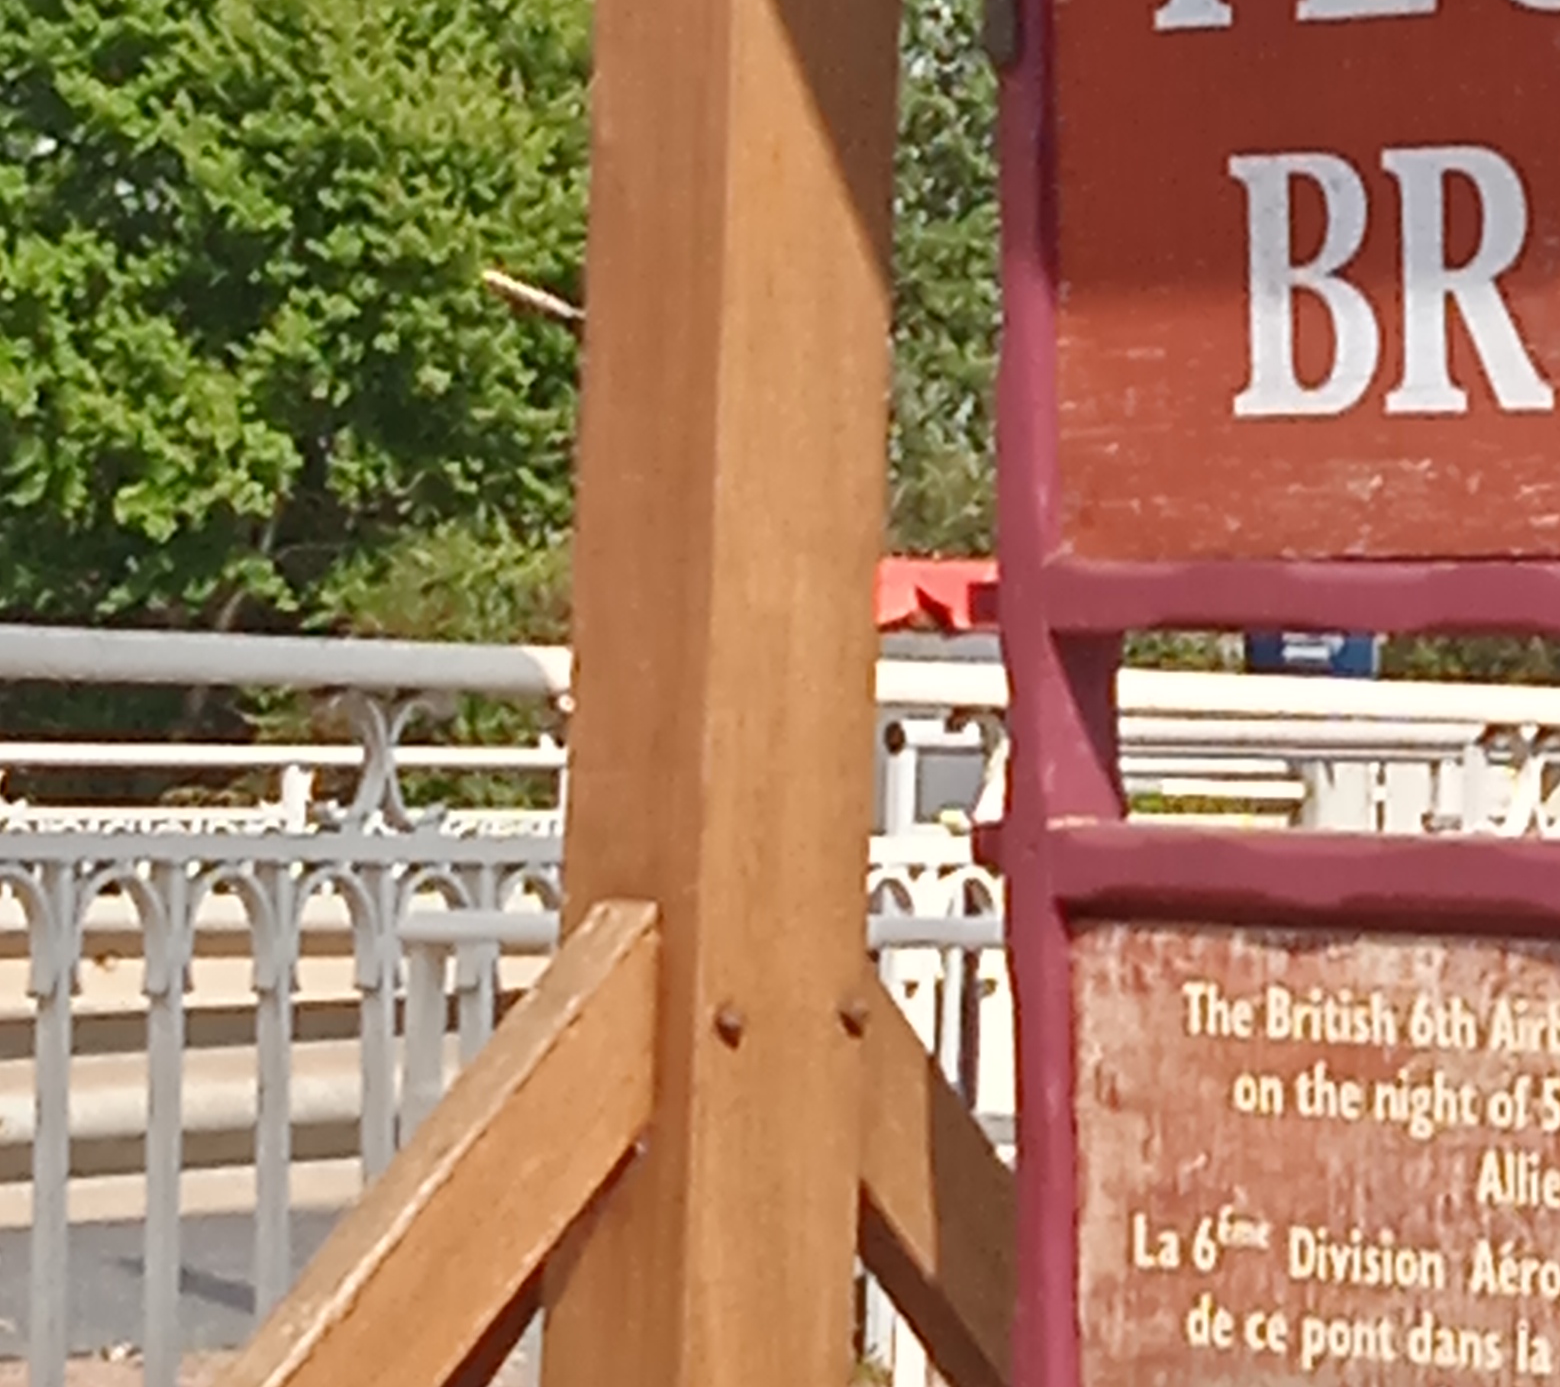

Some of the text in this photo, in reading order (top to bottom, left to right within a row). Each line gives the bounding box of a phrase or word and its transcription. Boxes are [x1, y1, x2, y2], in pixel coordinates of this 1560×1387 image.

[1182, 983, 1251, 1037] The
[1266, 985, 1395, 1045] British
[1410, 997, 1478, 1051] 6th
[1233, 1075, 1285, 1115] on
[1295, 1059, 1362, 1121] the
[1372, 1068, 1478, 1141] night
[1488, 1074, 1533, 1131] of
[1133, 1212, 1181, 1269] La
[1288, 1223, 1446, 1291] Division
[1186, 1291, 1234, 1349] de
[1244, 1309, 1289, 1353] ce
[1301, 1315, 1396, 1371] pont
[1407, 1309, 1502, 1373] dans
[1516, 1321, 1551, 1375] la
